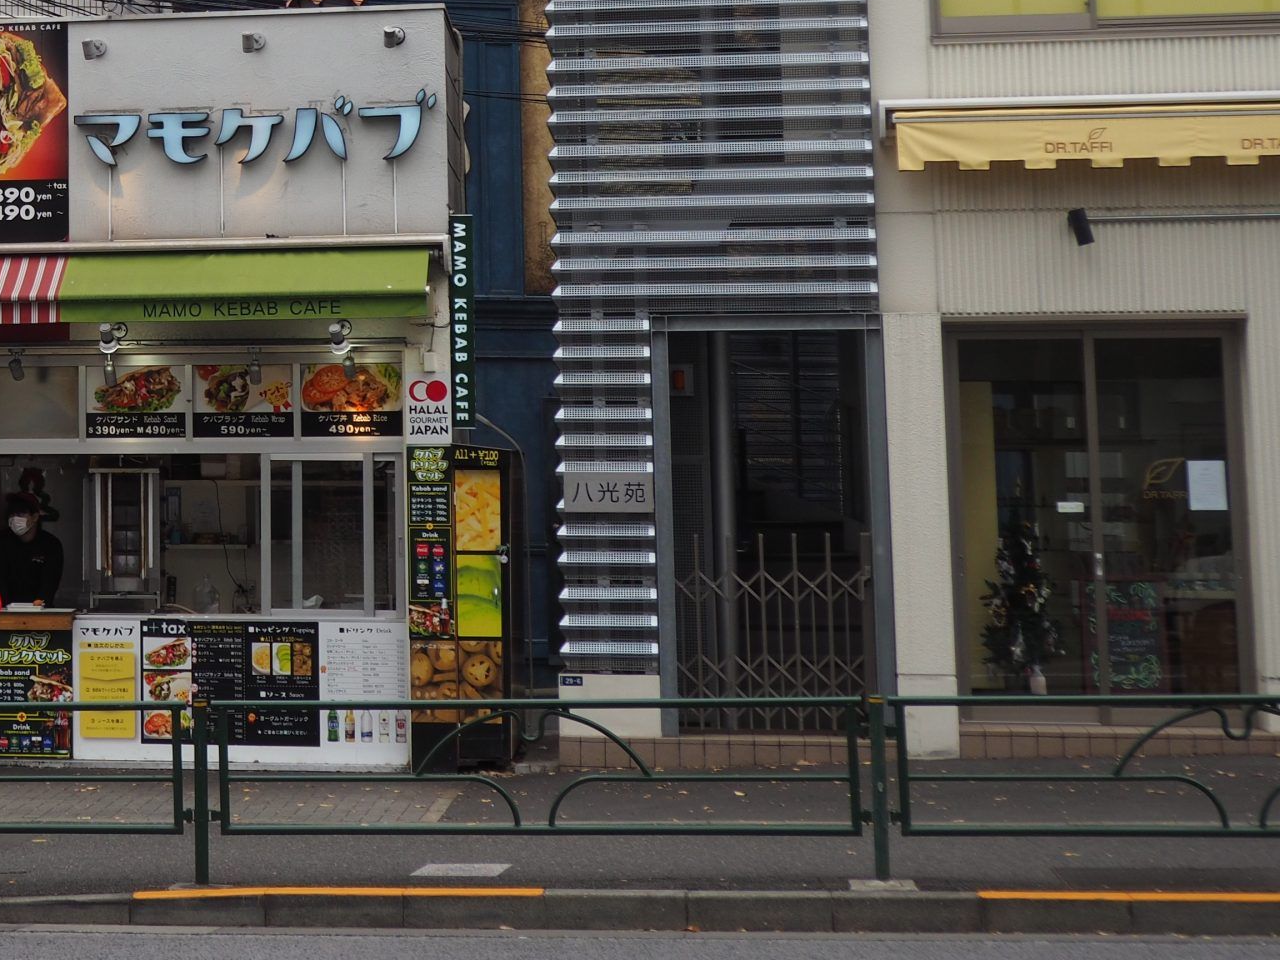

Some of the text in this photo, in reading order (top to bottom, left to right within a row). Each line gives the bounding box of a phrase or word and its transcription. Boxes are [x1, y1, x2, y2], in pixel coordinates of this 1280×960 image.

[8, 24, 36, 32] KEBAB
[74, 89, 437, 166] マモケバブ
[1044, 141, 1113, 154] DR.TAFFI
[1240, 138, 1280, 150] DR.T
[143, 300, 342, 318] MAMO KEBAB CAFE
[453, 222, 469, 421] MAMO KEBAB CAFE
[409, 405, 448, 414] HALAL
[143, 415, 177, 423] Kebab Sand
[409, 425, 449, 435] JAPAN
[410, 460, 449, 471] ドリンク
[415, 470, 445, 481] セット
[572, 481, 646, 504] 八光苑
[80, 626, 135, 636] マモケバブ
